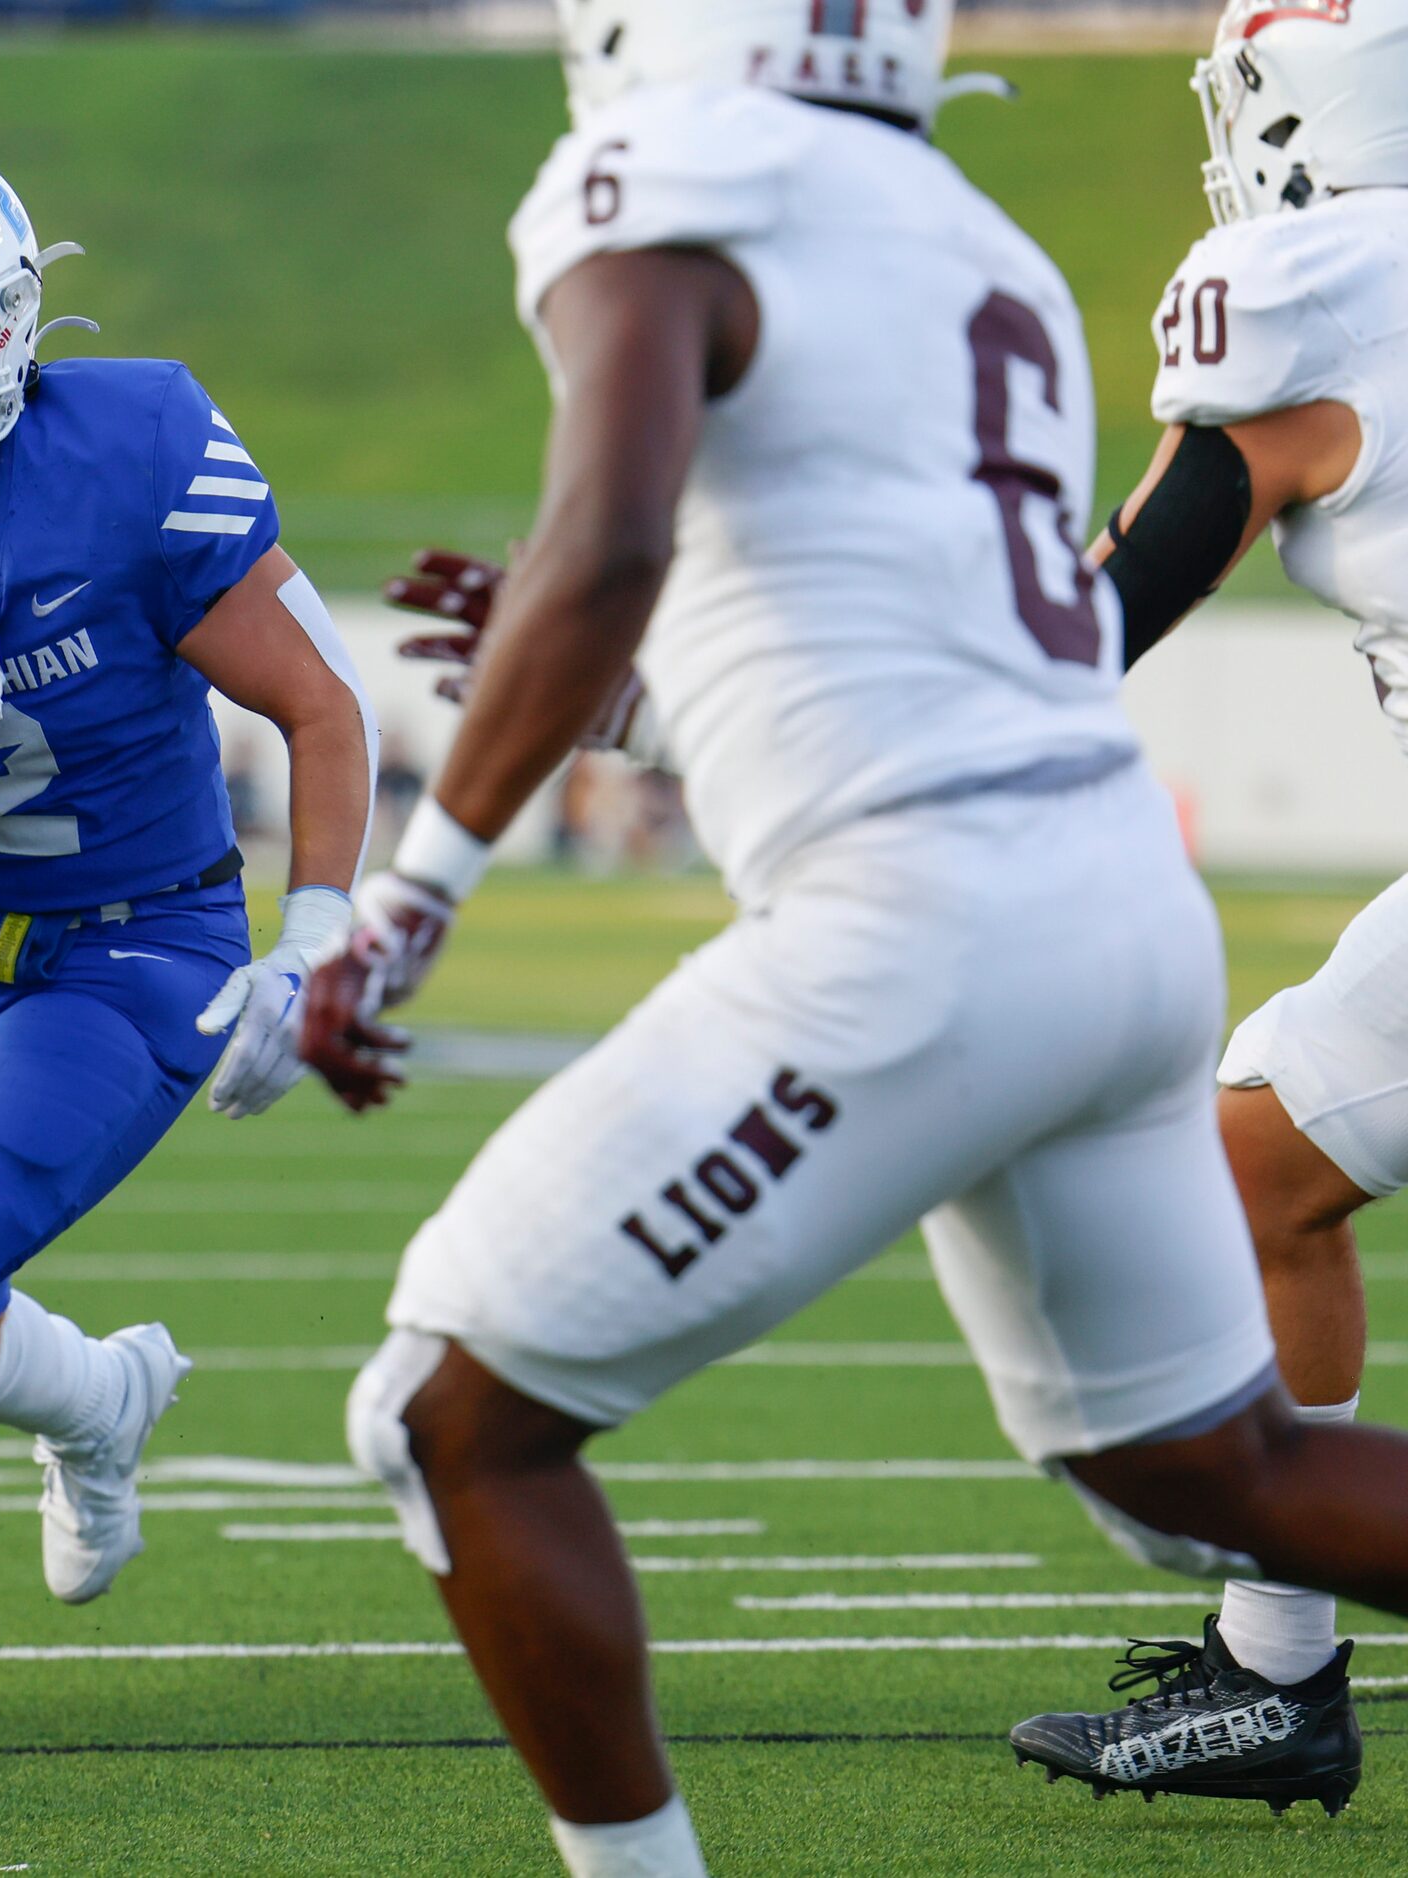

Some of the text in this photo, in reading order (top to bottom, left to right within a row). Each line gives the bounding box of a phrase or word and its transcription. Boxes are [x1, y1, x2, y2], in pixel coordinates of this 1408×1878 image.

[584, 141, 627, 225] 6
[1163, 278, 1228, 366] 20
[968, 289, 1100, 667] 6
[3, 627, 99, 694] HIAN
[620, 1066, 839, 1279] LIONS
